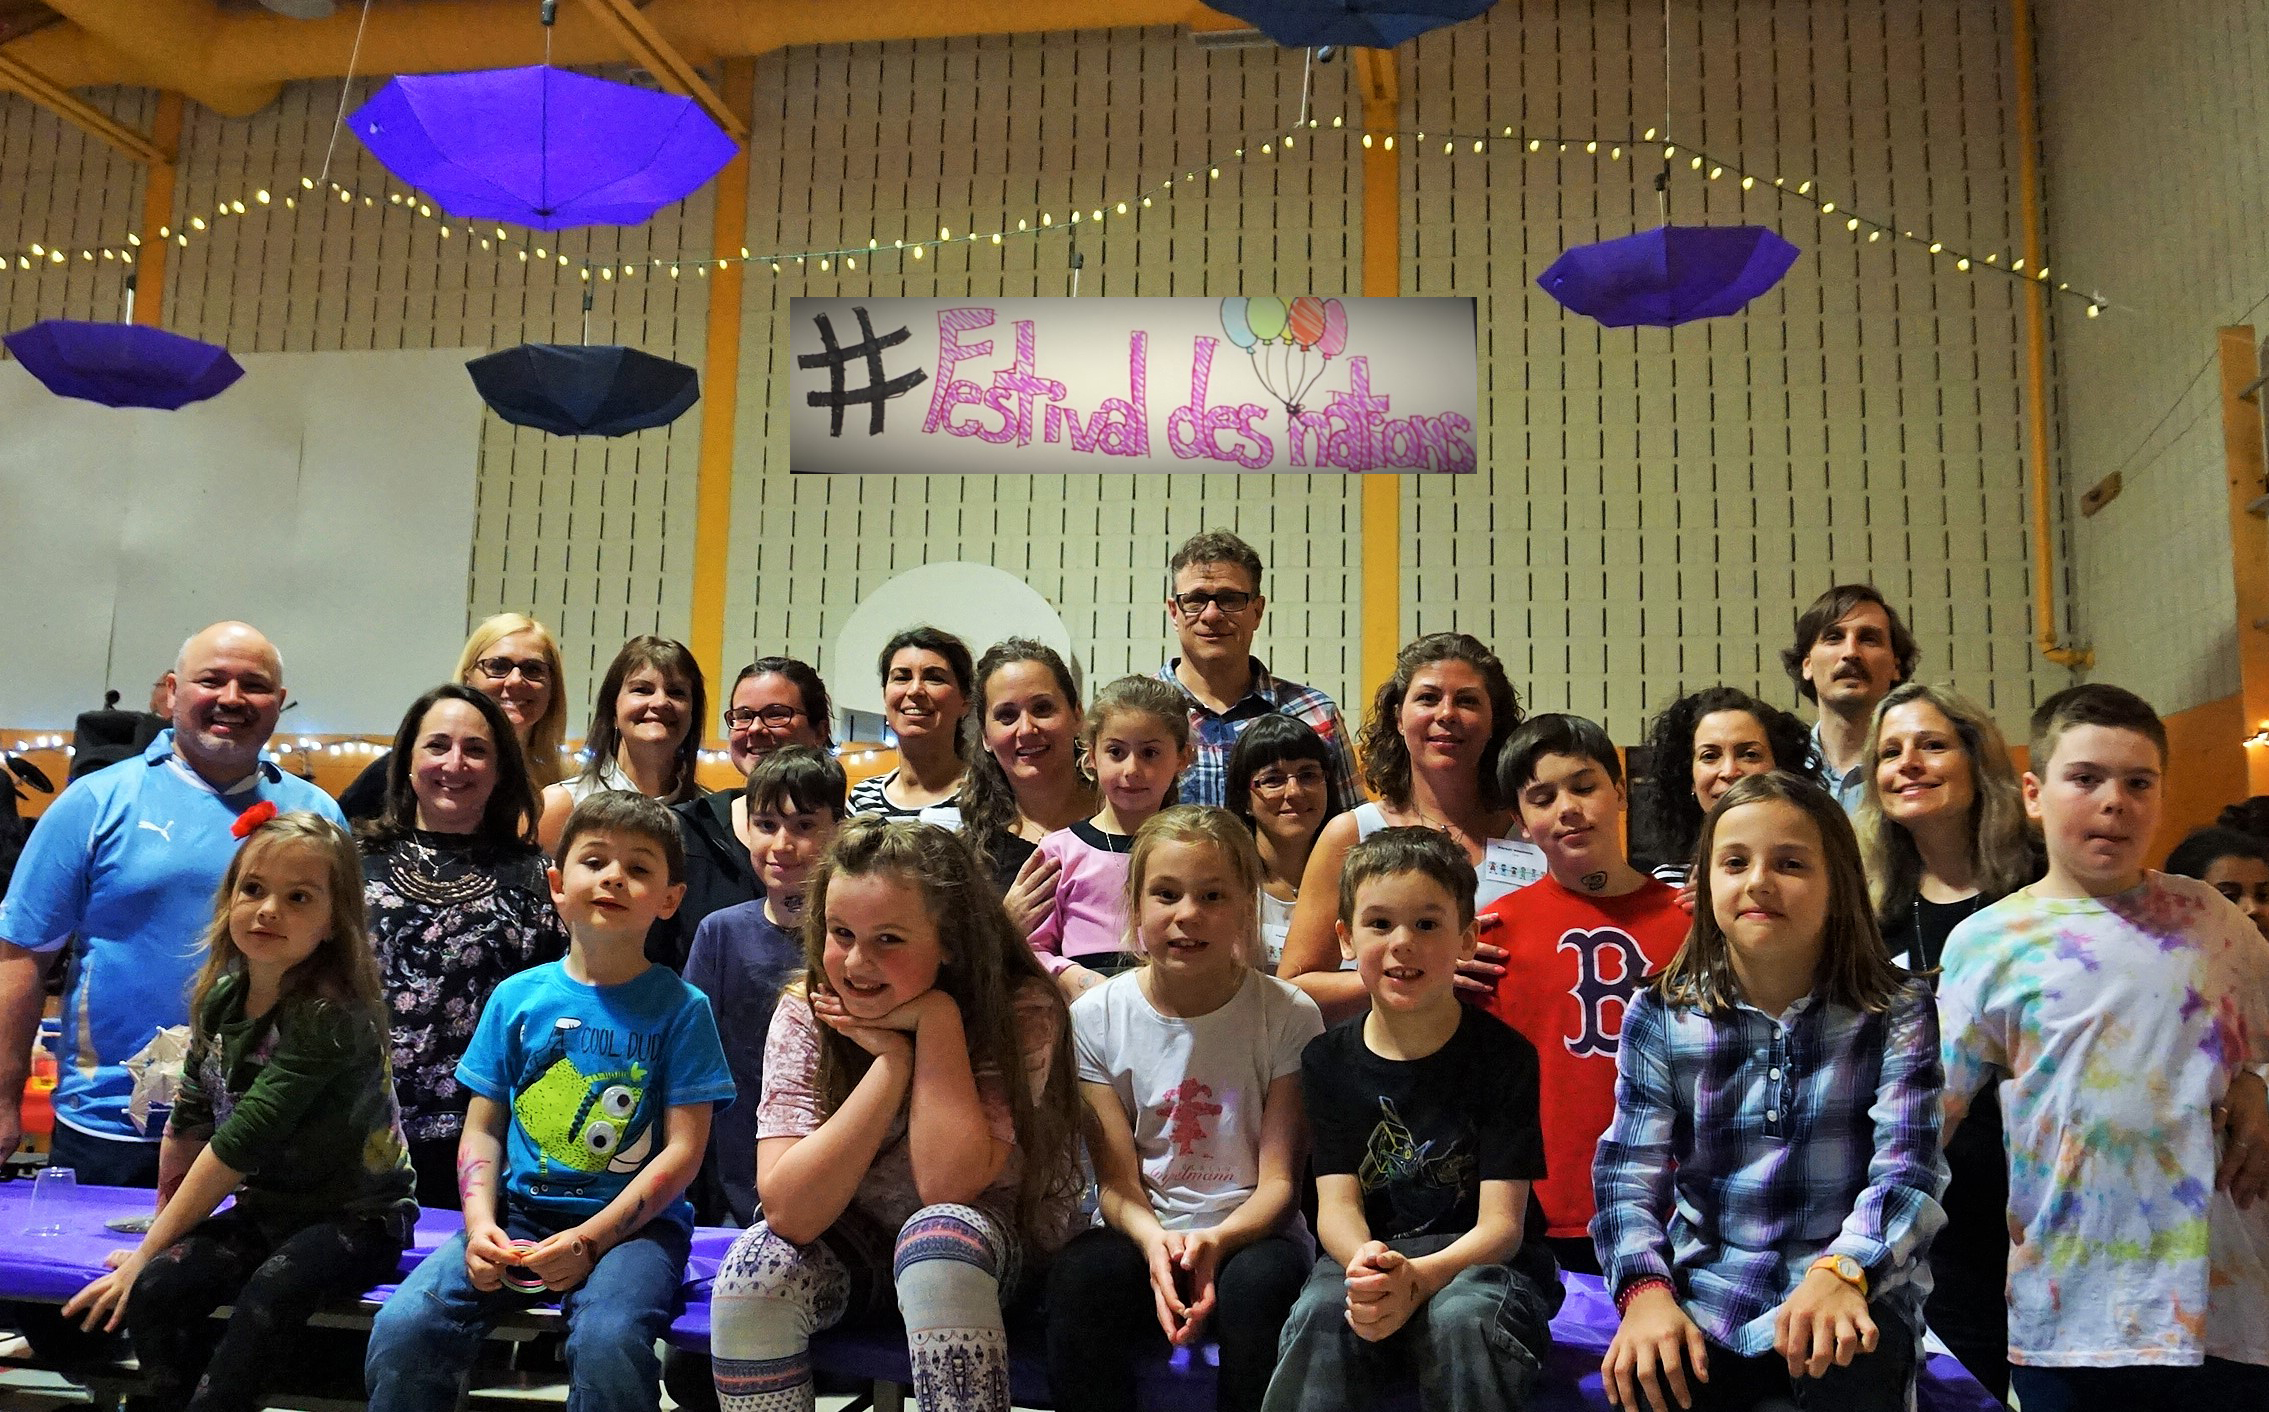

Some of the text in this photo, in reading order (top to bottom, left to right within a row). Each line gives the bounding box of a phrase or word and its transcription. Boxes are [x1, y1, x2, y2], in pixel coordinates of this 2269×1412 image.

[1556, 926, 1654, 1059] B
[581, 1026, 663, 1061] COOL DUD
